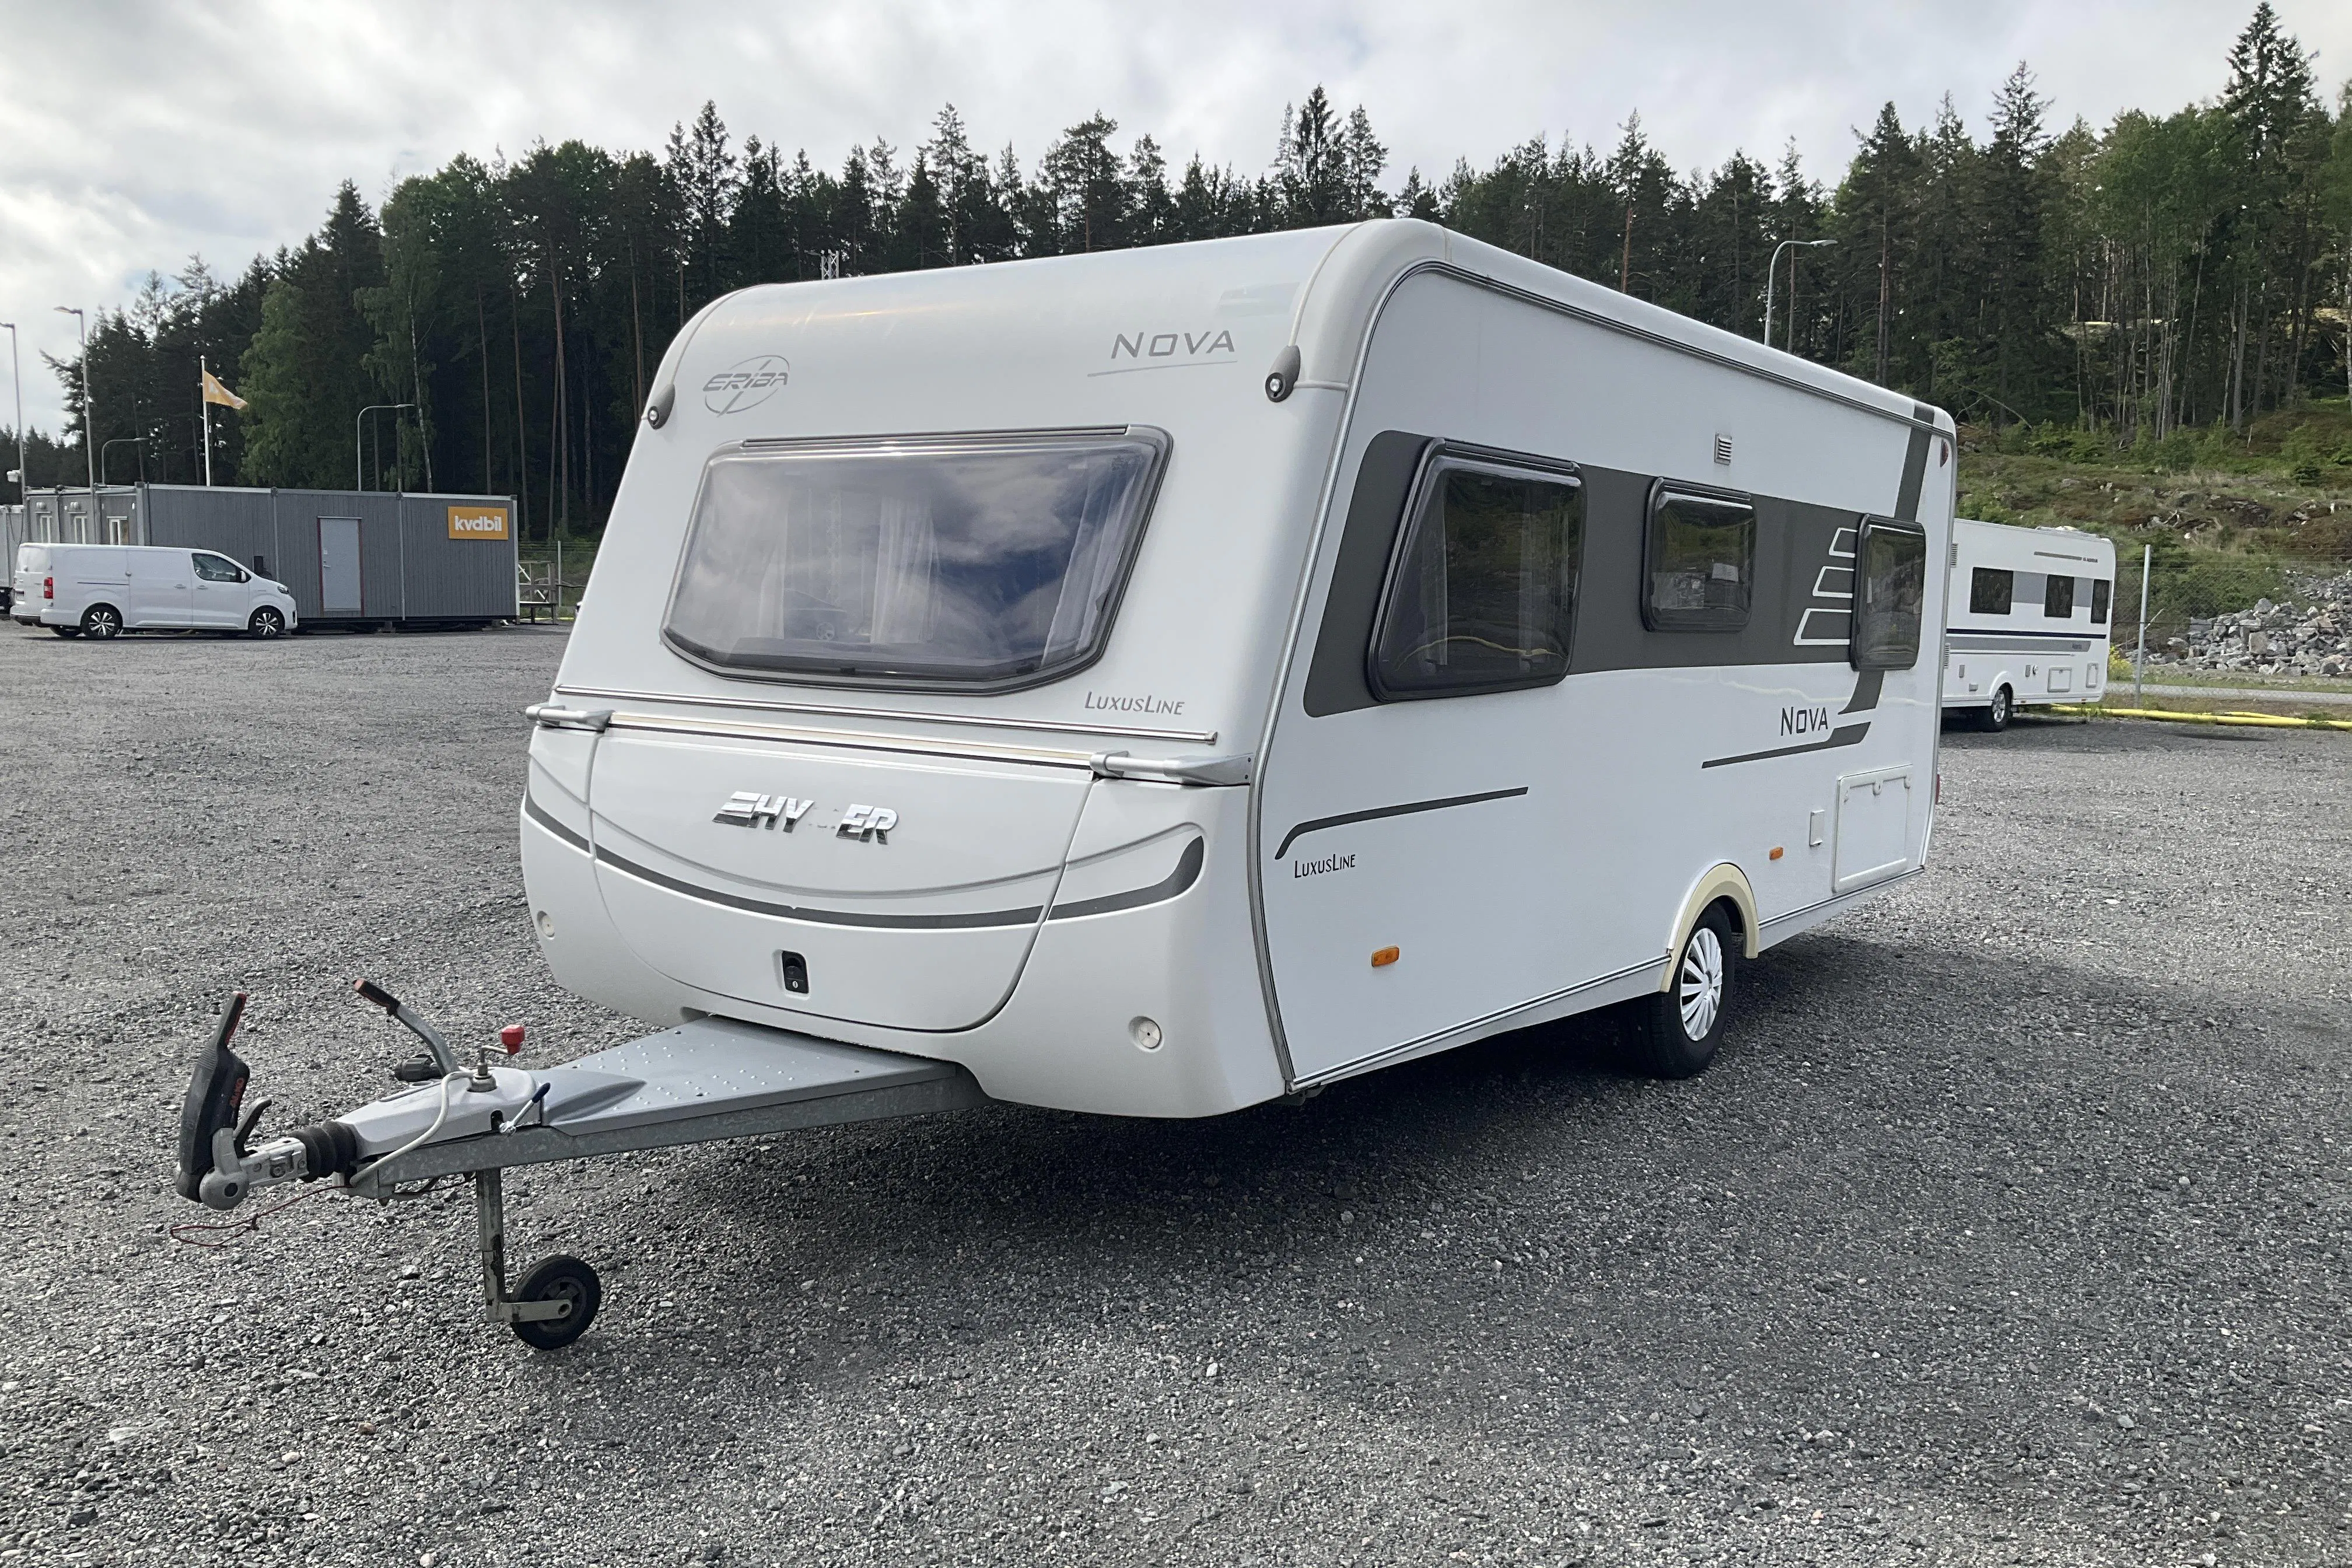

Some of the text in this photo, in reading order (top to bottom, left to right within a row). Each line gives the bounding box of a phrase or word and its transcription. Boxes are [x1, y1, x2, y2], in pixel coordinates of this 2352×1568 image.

[1110, 330, 1236, 359] NOVA
[702, 372, 789, 392] ERIBA
[454, 515, 502, 531] kvdbil
[1780, 706, 1828, 736] NOVA
